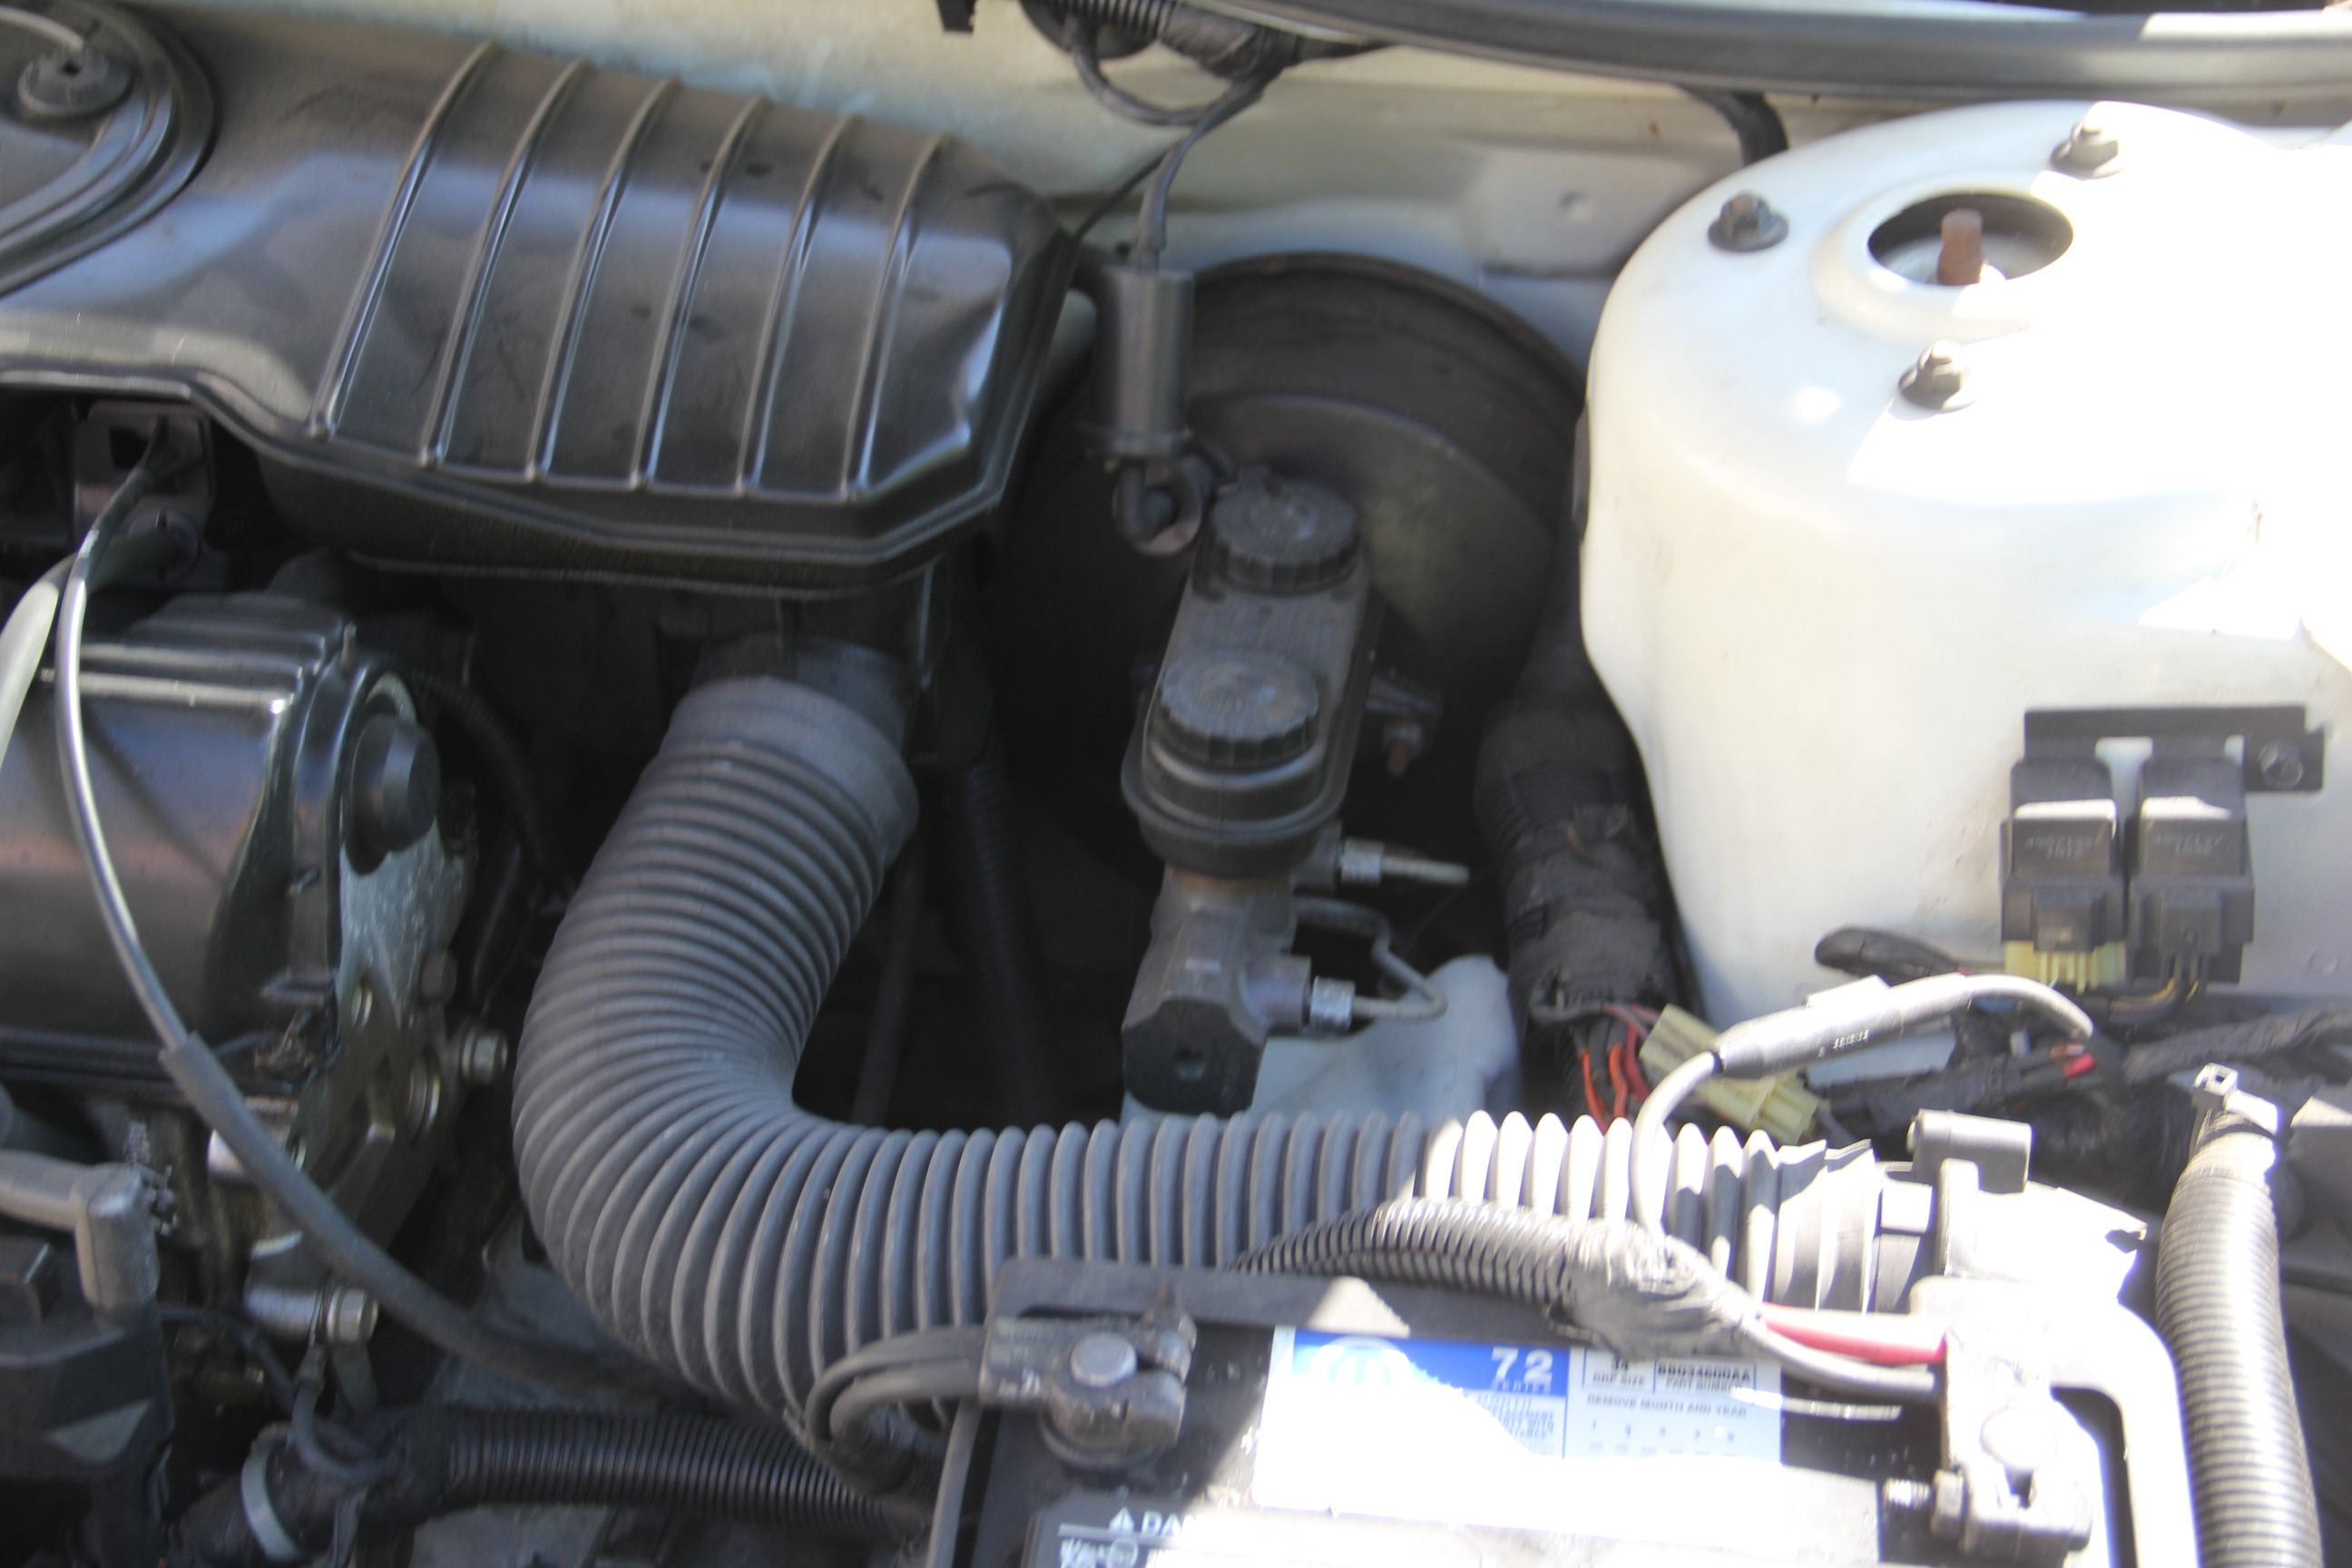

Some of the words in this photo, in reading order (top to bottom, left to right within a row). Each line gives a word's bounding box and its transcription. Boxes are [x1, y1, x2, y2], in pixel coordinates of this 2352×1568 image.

[1492, 1347, 1553, 1383] 72
[1587, 1393, 1637, 1408] REMOVE
[1640, 1398, 1684, 1412] MONTH
[1687, 1402, 1711, 1416] AND
[1715, 1405, 1747, 1418] YEAR
